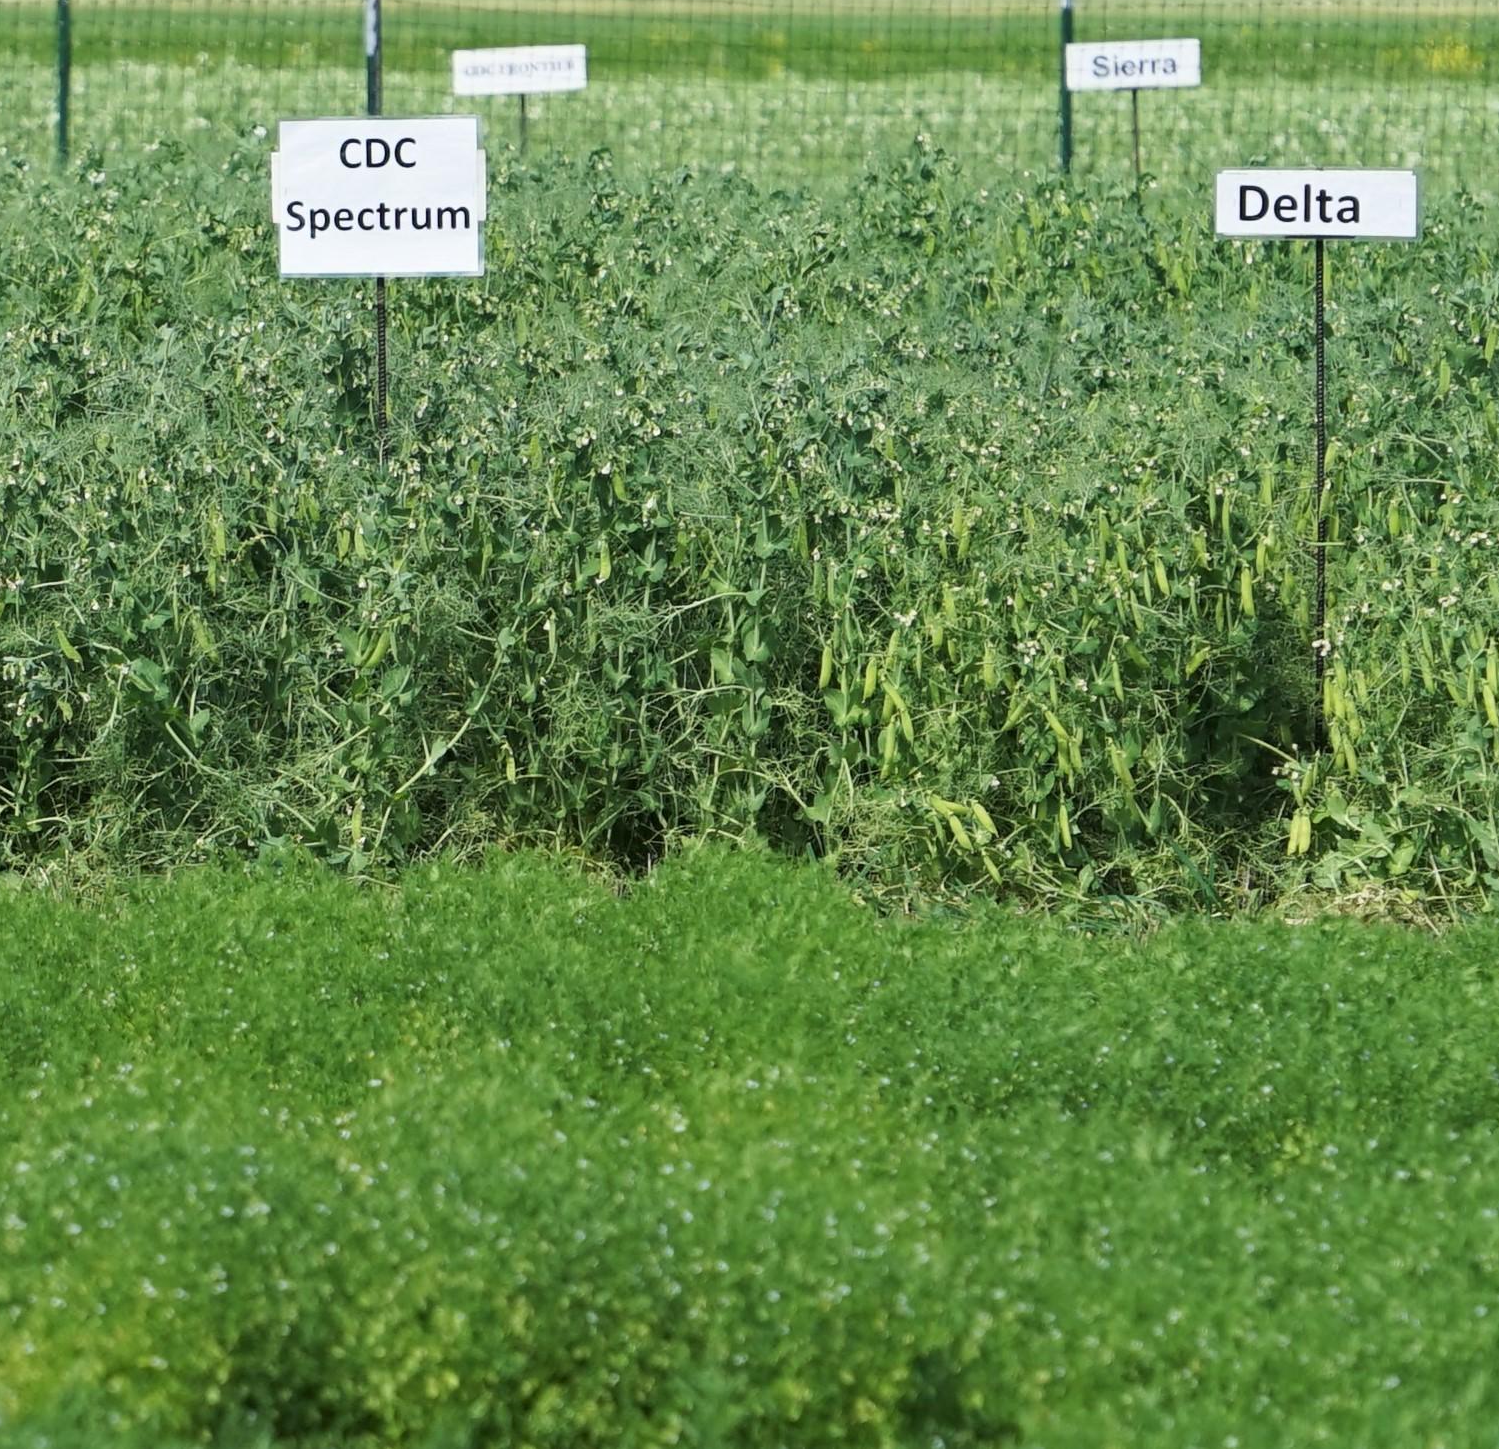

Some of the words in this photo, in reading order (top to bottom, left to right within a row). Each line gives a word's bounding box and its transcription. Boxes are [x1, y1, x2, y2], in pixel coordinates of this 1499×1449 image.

[1092, 55, 1177, 78] Sierra
[338, 137, 418, 169] CDC
[285, 200, 471, 240] Spectrum
[1238, 183, 1361, 224] Delta
